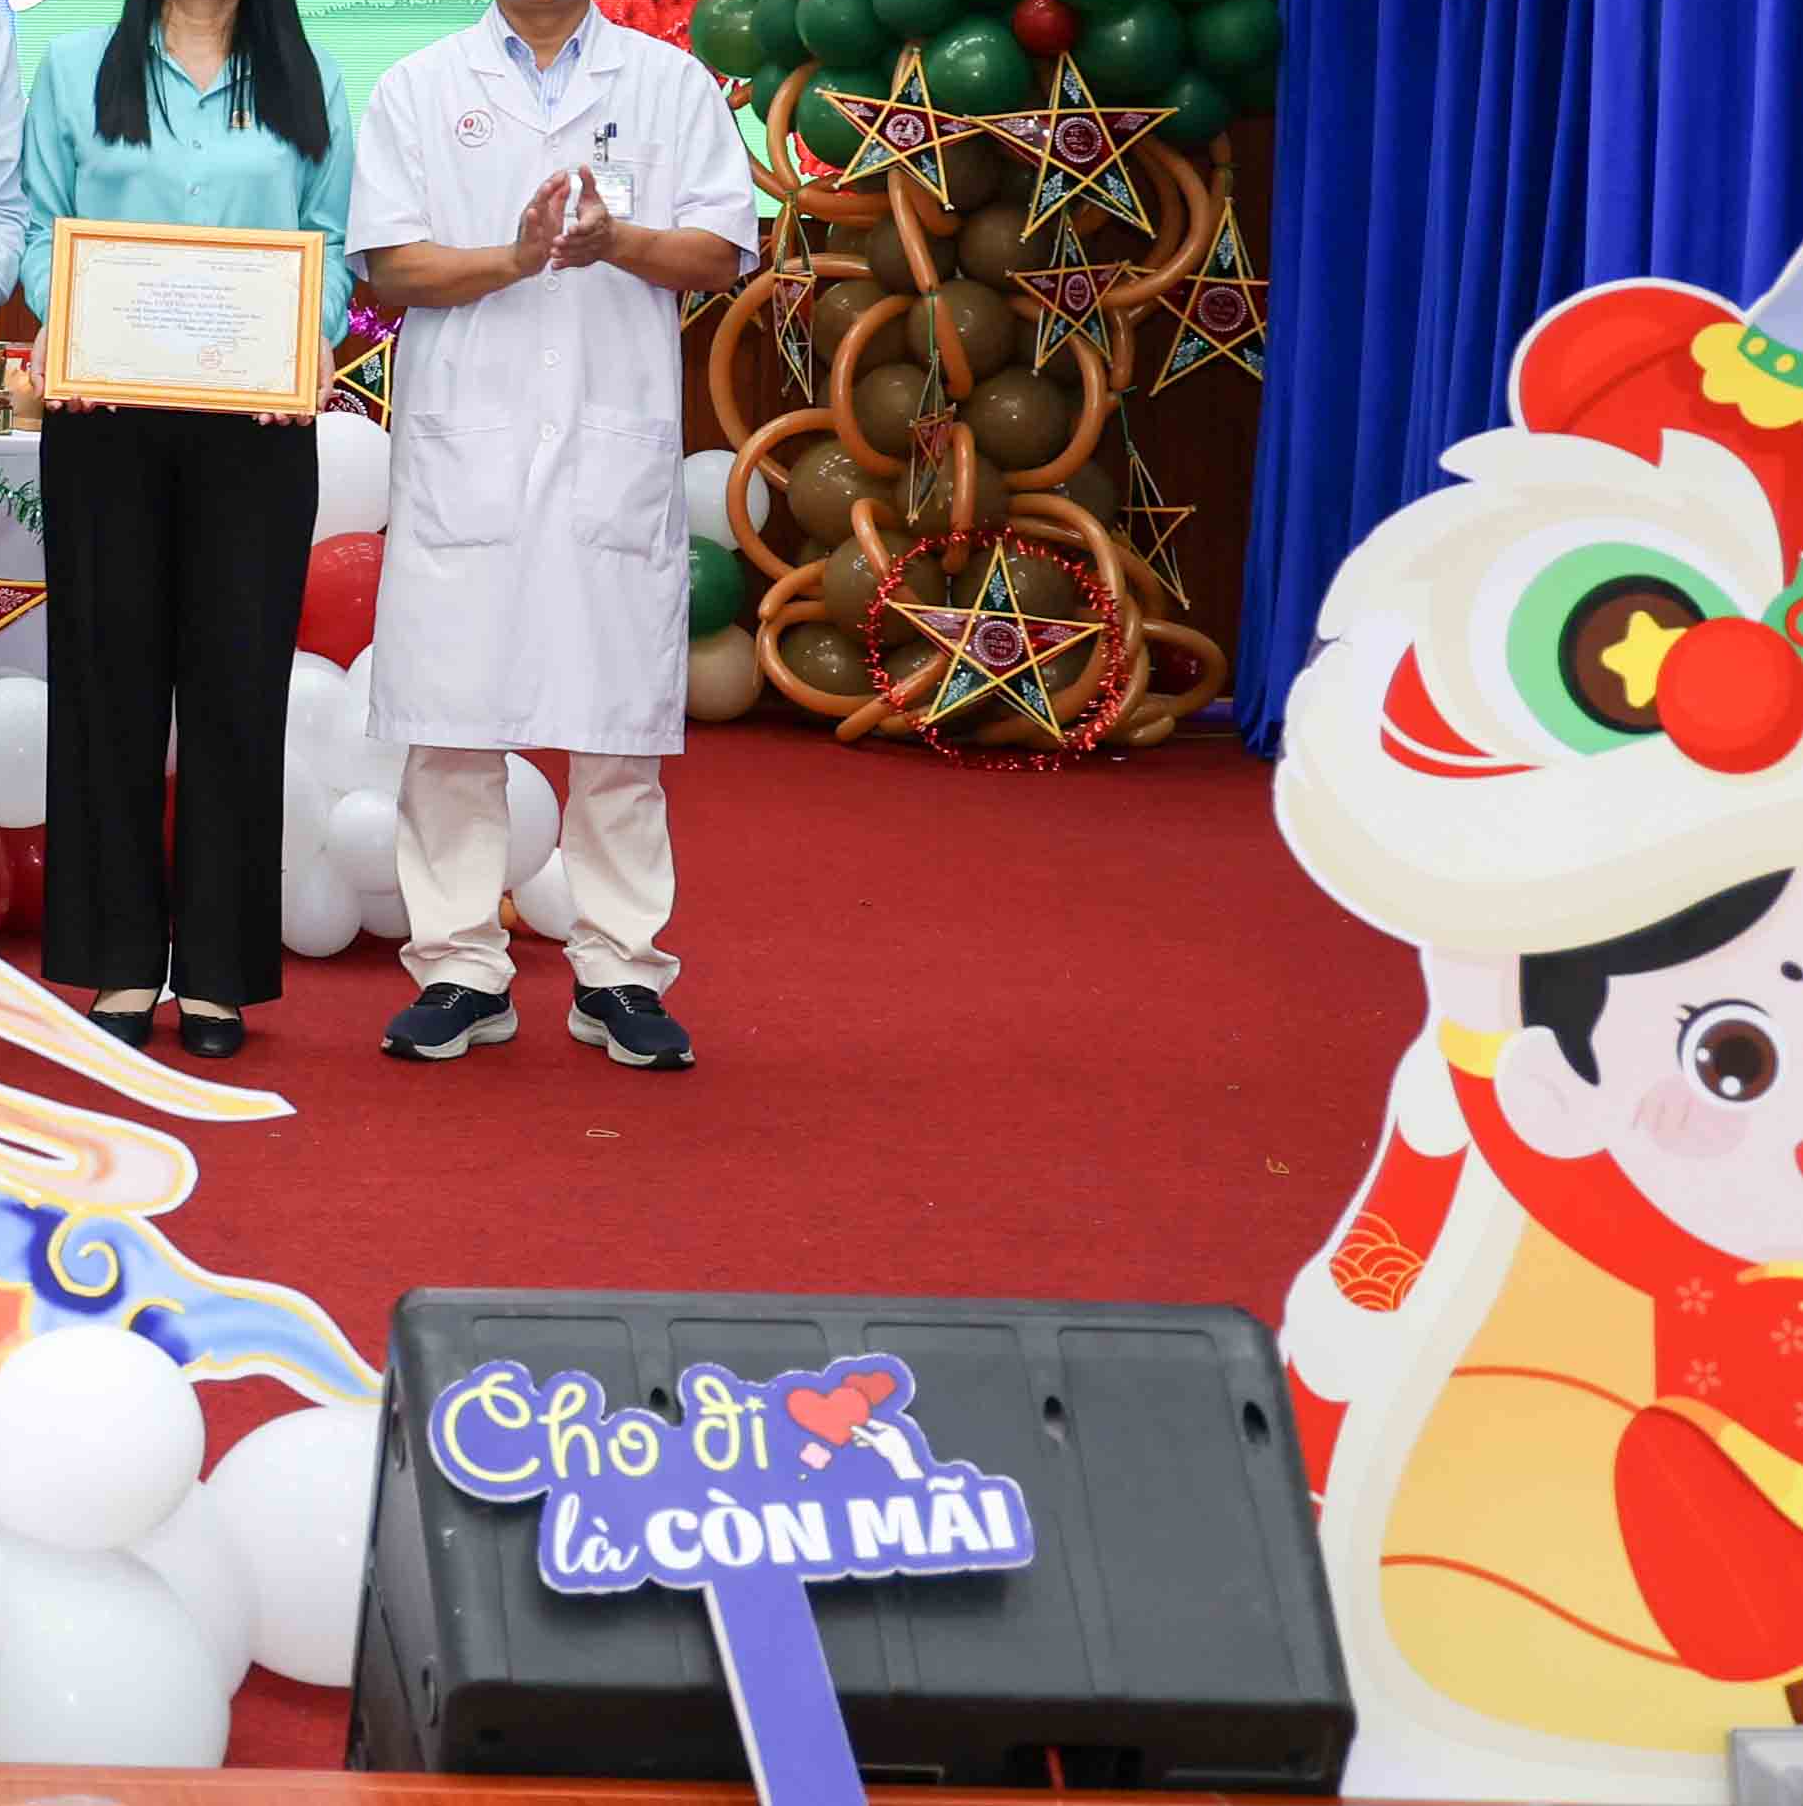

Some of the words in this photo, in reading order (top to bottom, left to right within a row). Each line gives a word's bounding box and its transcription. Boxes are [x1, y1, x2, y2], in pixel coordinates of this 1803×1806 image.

[443, 1370, 661, 1483] Cho
[694, 1375, 771, 1472] đi
[553, 1492, 637, 1574] là
[645, 1487, 834, 1570] CÒN
[846, 1474, 1017, 1557] MÃI
